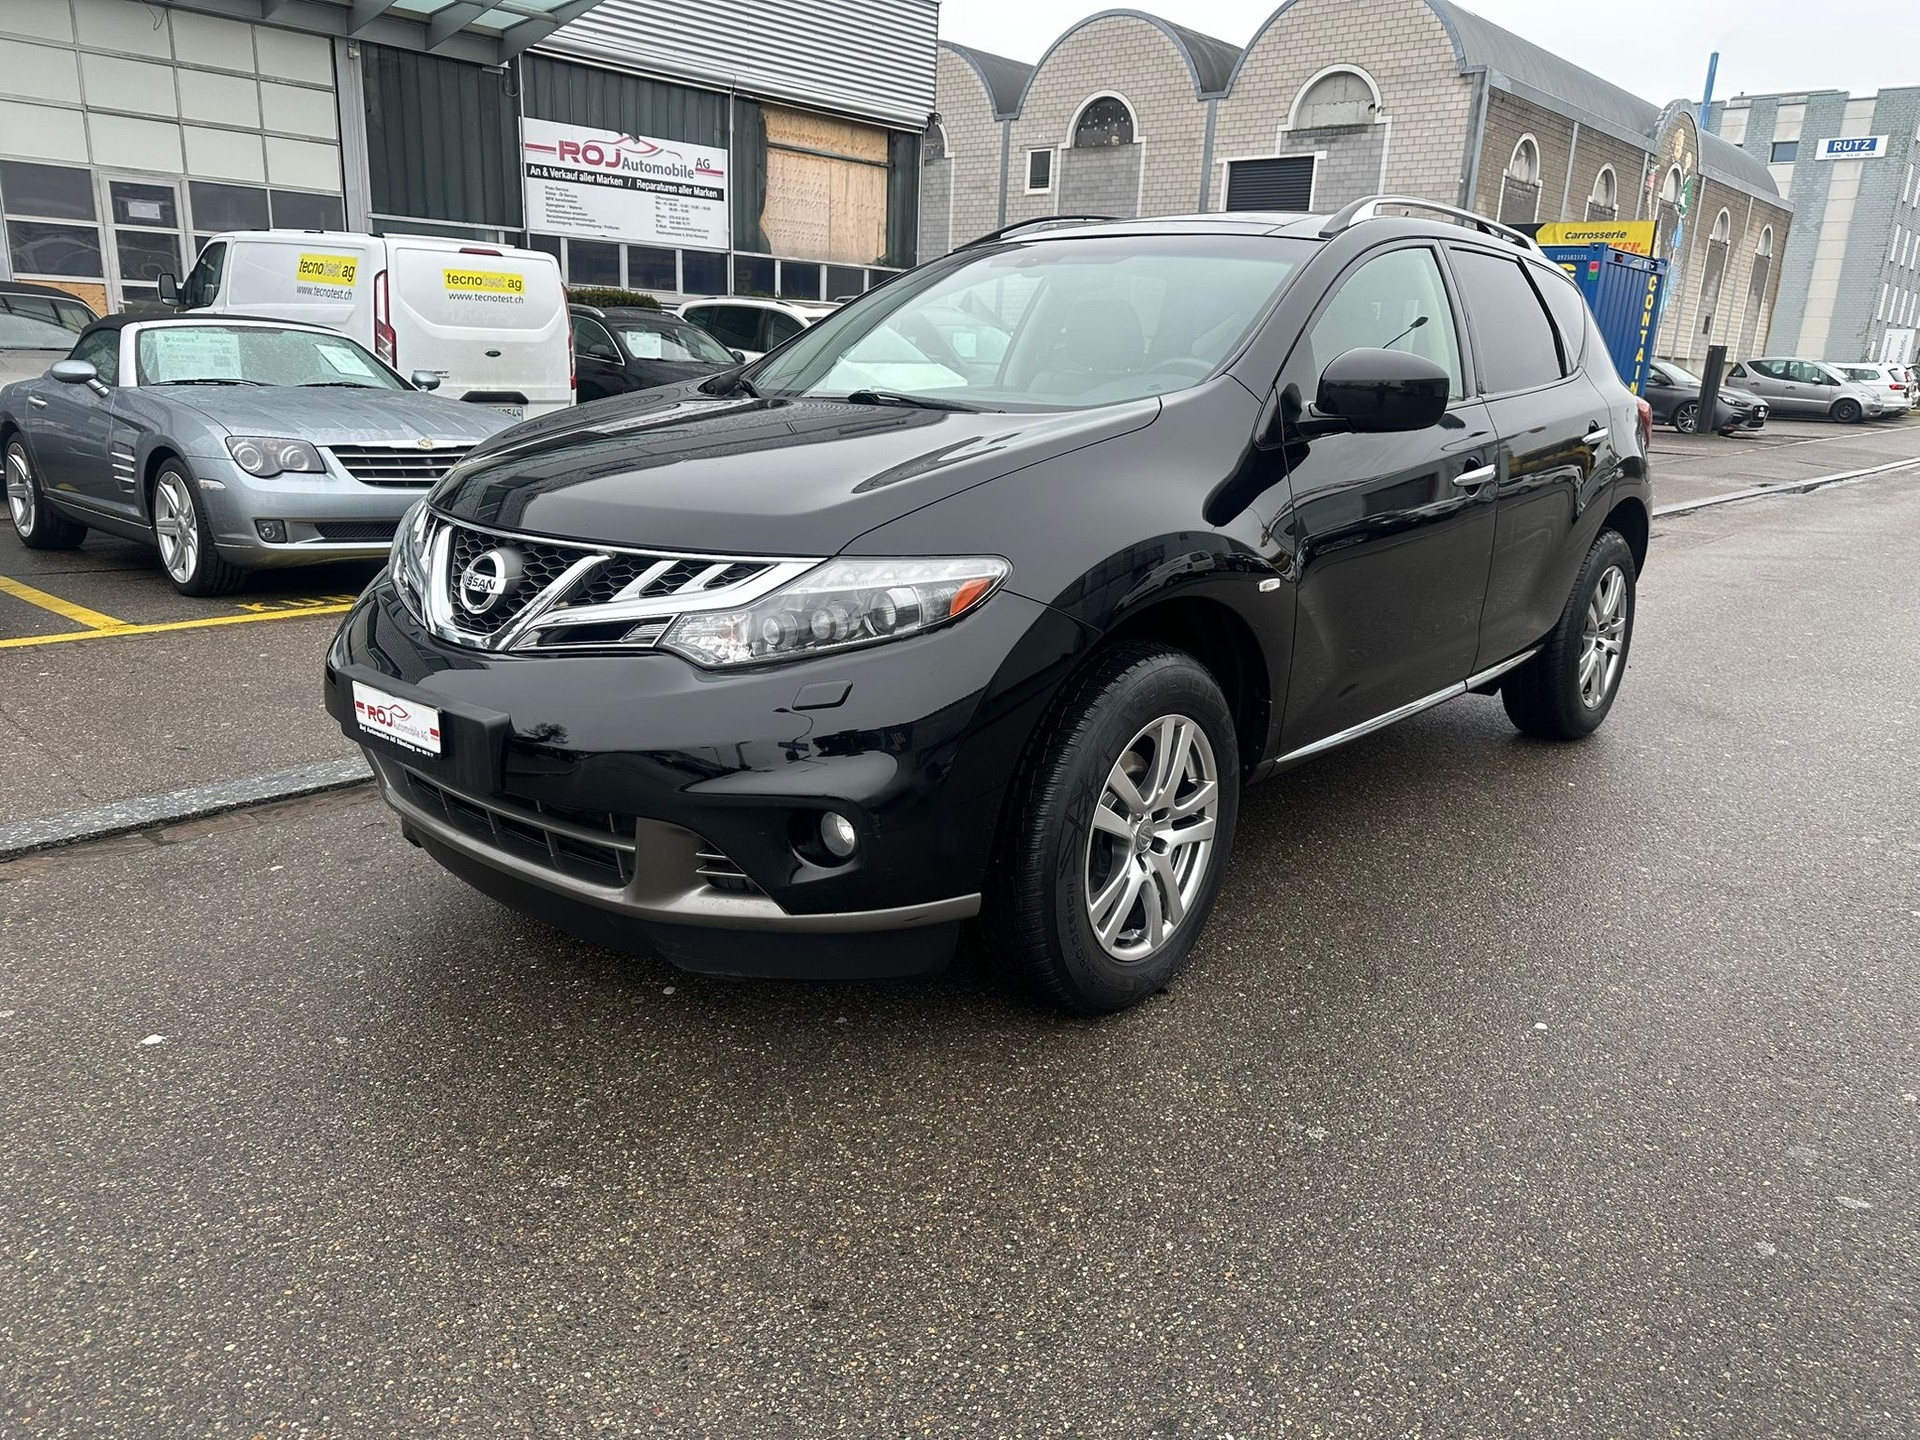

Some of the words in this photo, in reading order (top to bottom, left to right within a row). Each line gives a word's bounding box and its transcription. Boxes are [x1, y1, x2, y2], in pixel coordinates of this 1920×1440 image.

[1833, 140, 1871, 151] RUTZ
[558, 140, 621, 168] ROJ
[621, 157, 694, 179] Automobile
[695, 157, 711, 169] AG
[530, 165, 541, 176] An
[542, 167, 549, 177] &
[549, 168, 579, 181] Verkauf
[579, 171, 595, 182] aller
[596, 174, 623, 186] Marken
[636, 179, 677, 193] Reparaturen
[678, 184, 692, 195] aller
[693, 186, 718, 198] Marken
[1565, 231, 1627, 240] Carrosserie
[299, 259, 342, 277] tecnotest
[342, 266, 355, 282] ag
[447, 273, 505, 288] tecnotest
[507, 279, 522, 291] ag
[297, 285, 353, 300] www.tecnotest.ch
[448, 292, 524, 304] www.tecnotest.ch
[367, 704, 393, 728] ROJ
